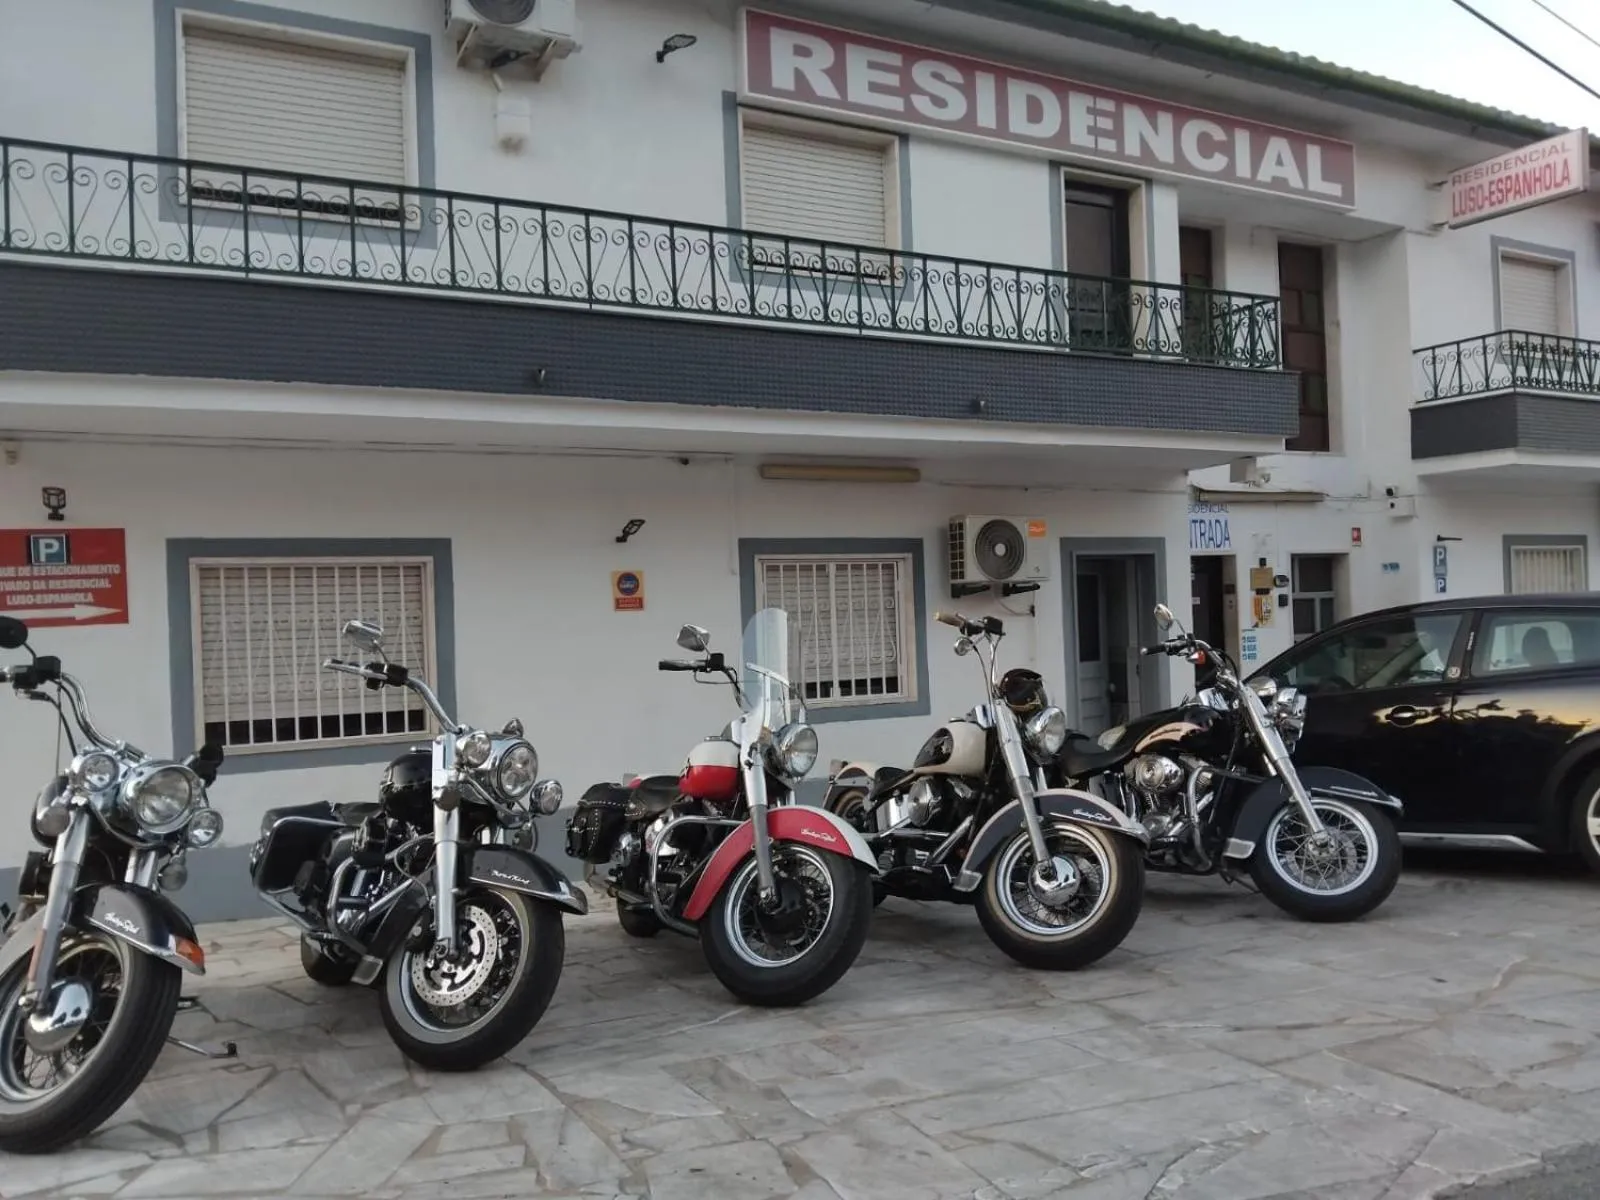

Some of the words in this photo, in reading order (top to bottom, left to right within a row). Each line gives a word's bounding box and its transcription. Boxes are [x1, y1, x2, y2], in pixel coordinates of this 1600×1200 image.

[769, 26, 1343, 198] RESIDENCIAL
[1452, 142, 1573, 187] RESIDENCIAL
[1452, 158, 1571, 218] LUSO-ESPANHOLA
[39, 538, 60, 562] P
